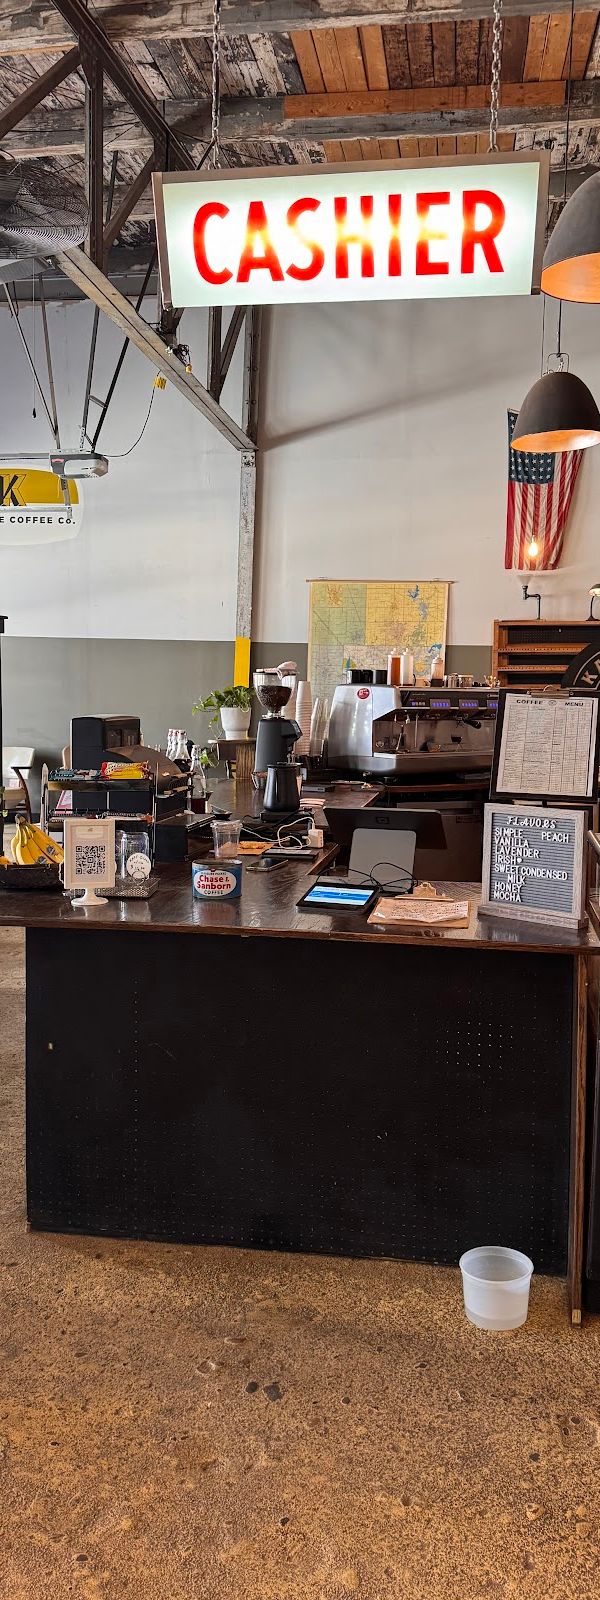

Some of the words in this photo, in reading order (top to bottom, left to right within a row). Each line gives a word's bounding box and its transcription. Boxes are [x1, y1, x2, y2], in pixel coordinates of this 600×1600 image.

[193, 189, 506, 285] CASHIER
[10, 516, 53, 524] COFFEE
[507, 816, 557, 829] FLAVORS
[495, 827, 524, 838] SIMPLE
[541, 831, 569, 843] PEACH
[494, 836, 530, 848] VANILLA
[495, 845, 540, 858] LAVENDER
[495, 855, 516, 865] IRISH
[199, 874, 224, 883] Chase
[494, 864, 519, 875] SWEET
[521, 866, 568, 881] CONDENSED
[196, 880, 231, 890] Sanborn
[507, 874, 526, 885] MILK
[494, 881, 522, 893] HONEY
[493, 890, 522, 902] MOCHA
